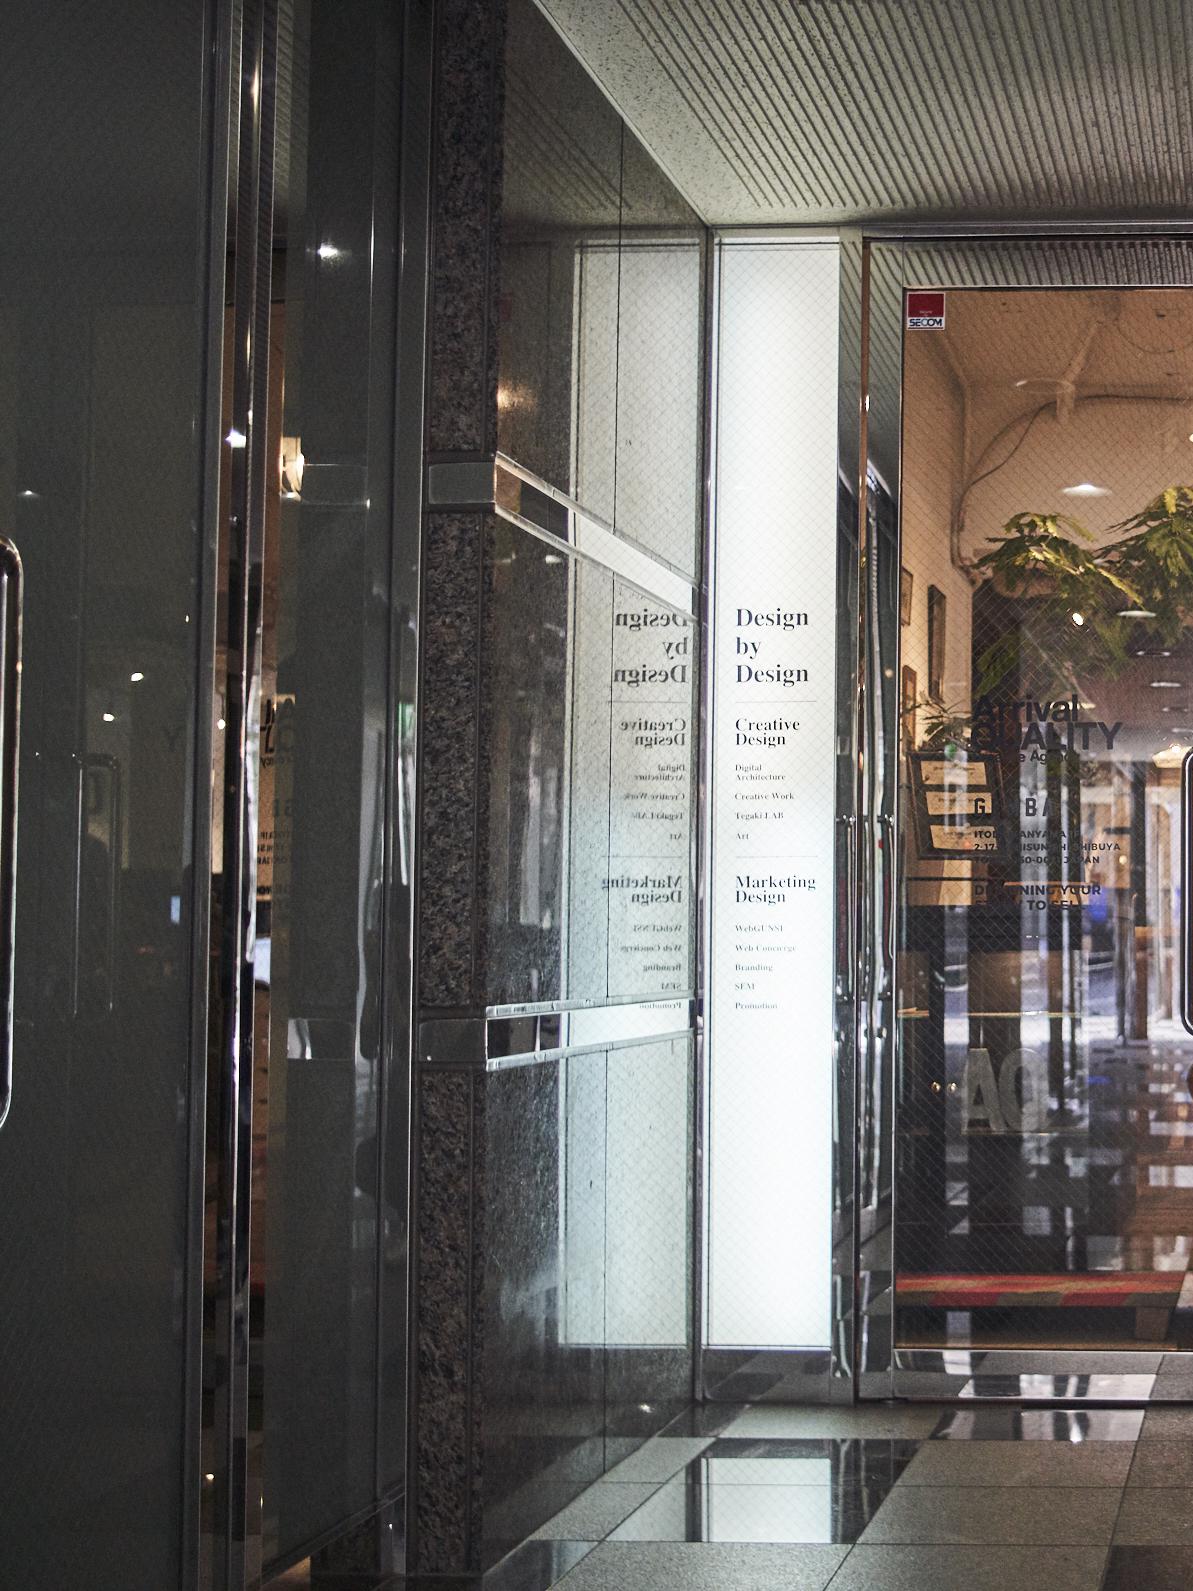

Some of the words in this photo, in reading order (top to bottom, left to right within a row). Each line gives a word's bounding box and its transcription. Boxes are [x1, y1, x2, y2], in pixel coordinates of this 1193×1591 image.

[909, 318, 943, 327] SECOM
[736, 608, 809, 631] Design
[736, 637, 761, 659] by
[736, 664, 809, 687] Design
[972, 694, 1078, 722] Arival
[735, 718, 800, 731] Creative
[736, 733, 786, 748] Design
[735, 764, 762, 772] Digital
[734, 792, 769, 800] Creative
[771, 792, 794, 800] Work
[1074, 843, 1121, 851] HIBUYA
[1063, 856, 1100, 864] JPAN
[736, 875, 816, 891] Marketing
[736, 890, 786, 905] Design
[735, 944, 754, 952] Web
